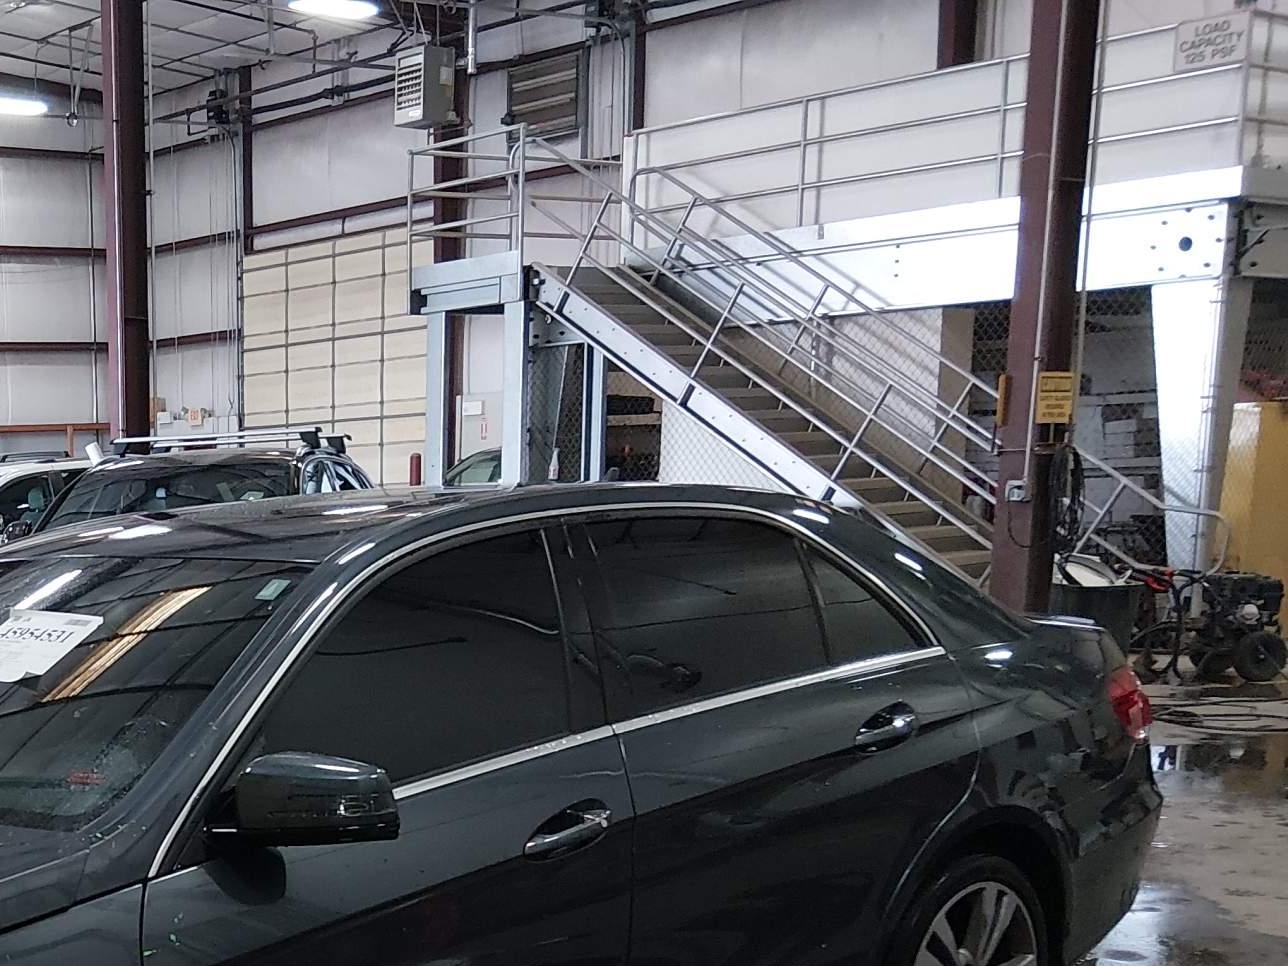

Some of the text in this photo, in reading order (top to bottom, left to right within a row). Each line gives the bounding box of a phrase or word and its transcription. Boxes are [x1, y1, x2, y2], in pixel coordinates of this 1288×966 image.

[1194, 20, 1231, 37] LOAD
[1179, 30, 1245, 53] CAPACITY
[1183, 49, 1206, 64] 125
[0, 627, 74, 643] 45954531
